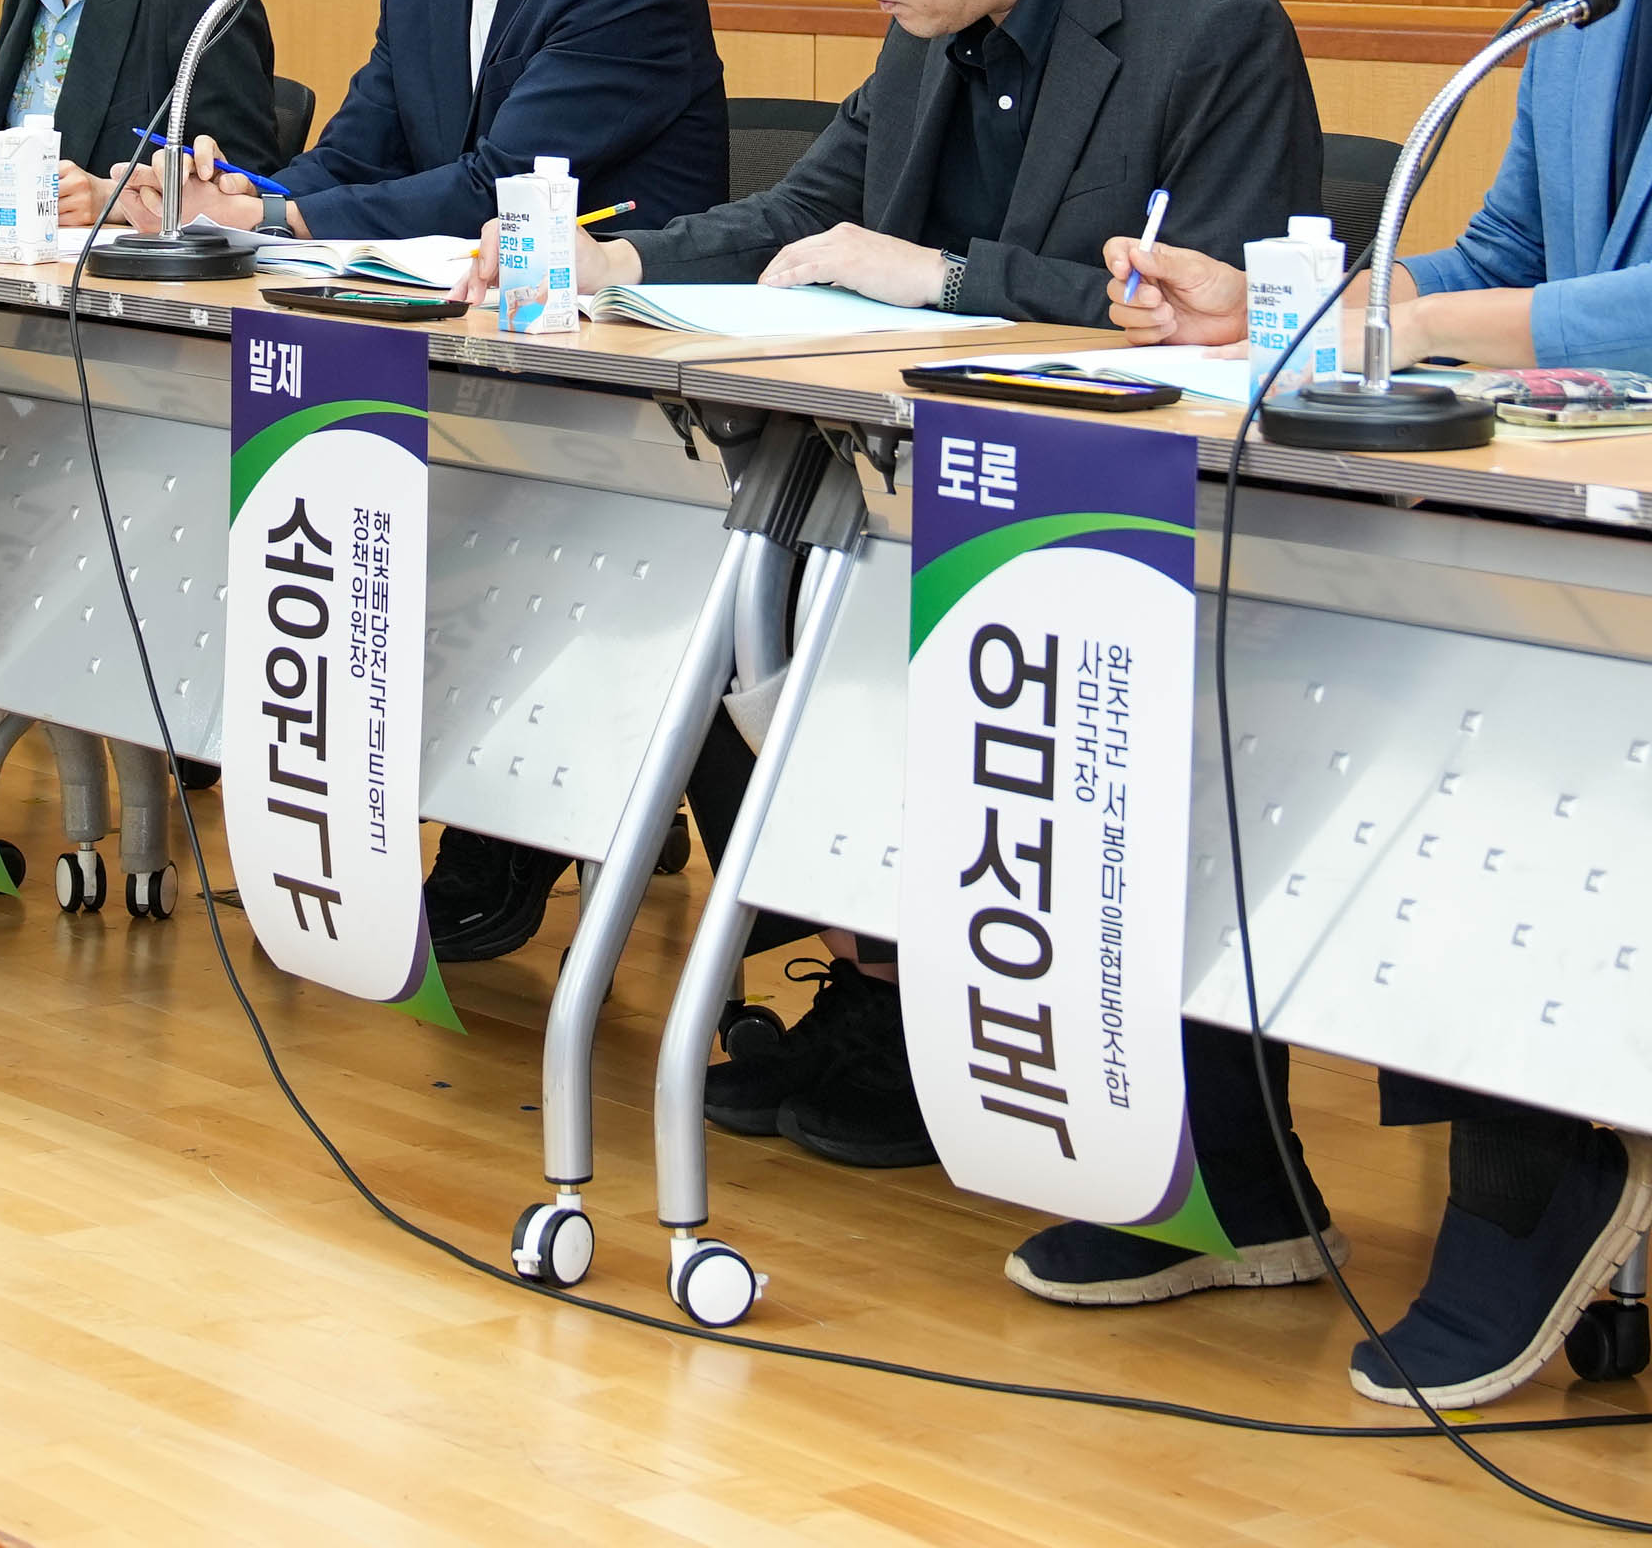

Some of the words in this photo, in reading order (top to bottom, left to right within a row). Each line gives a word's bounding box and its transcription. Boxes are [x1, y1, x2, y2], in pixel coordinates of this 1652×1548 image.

[37, 200, 59, 217] WATE
[521, 237, 535, 252] 물
[249, 338, 303, 399] 발제
[937, 436, 1019, 510] 토론
[348, 507, 372, 679] 정책위원장
[262, 497, 342, 941] 송원규
[365, 511, 392, 855] 햇빛배당전국네트워크
[1073, 640, 1105, 803] 사무국장
[1104, 644, 1133, 768] 완주군
[959, 621, 1078, 1161] 엄성복
[1099, 781, 1132, 1109] 서봉마을협동조합
